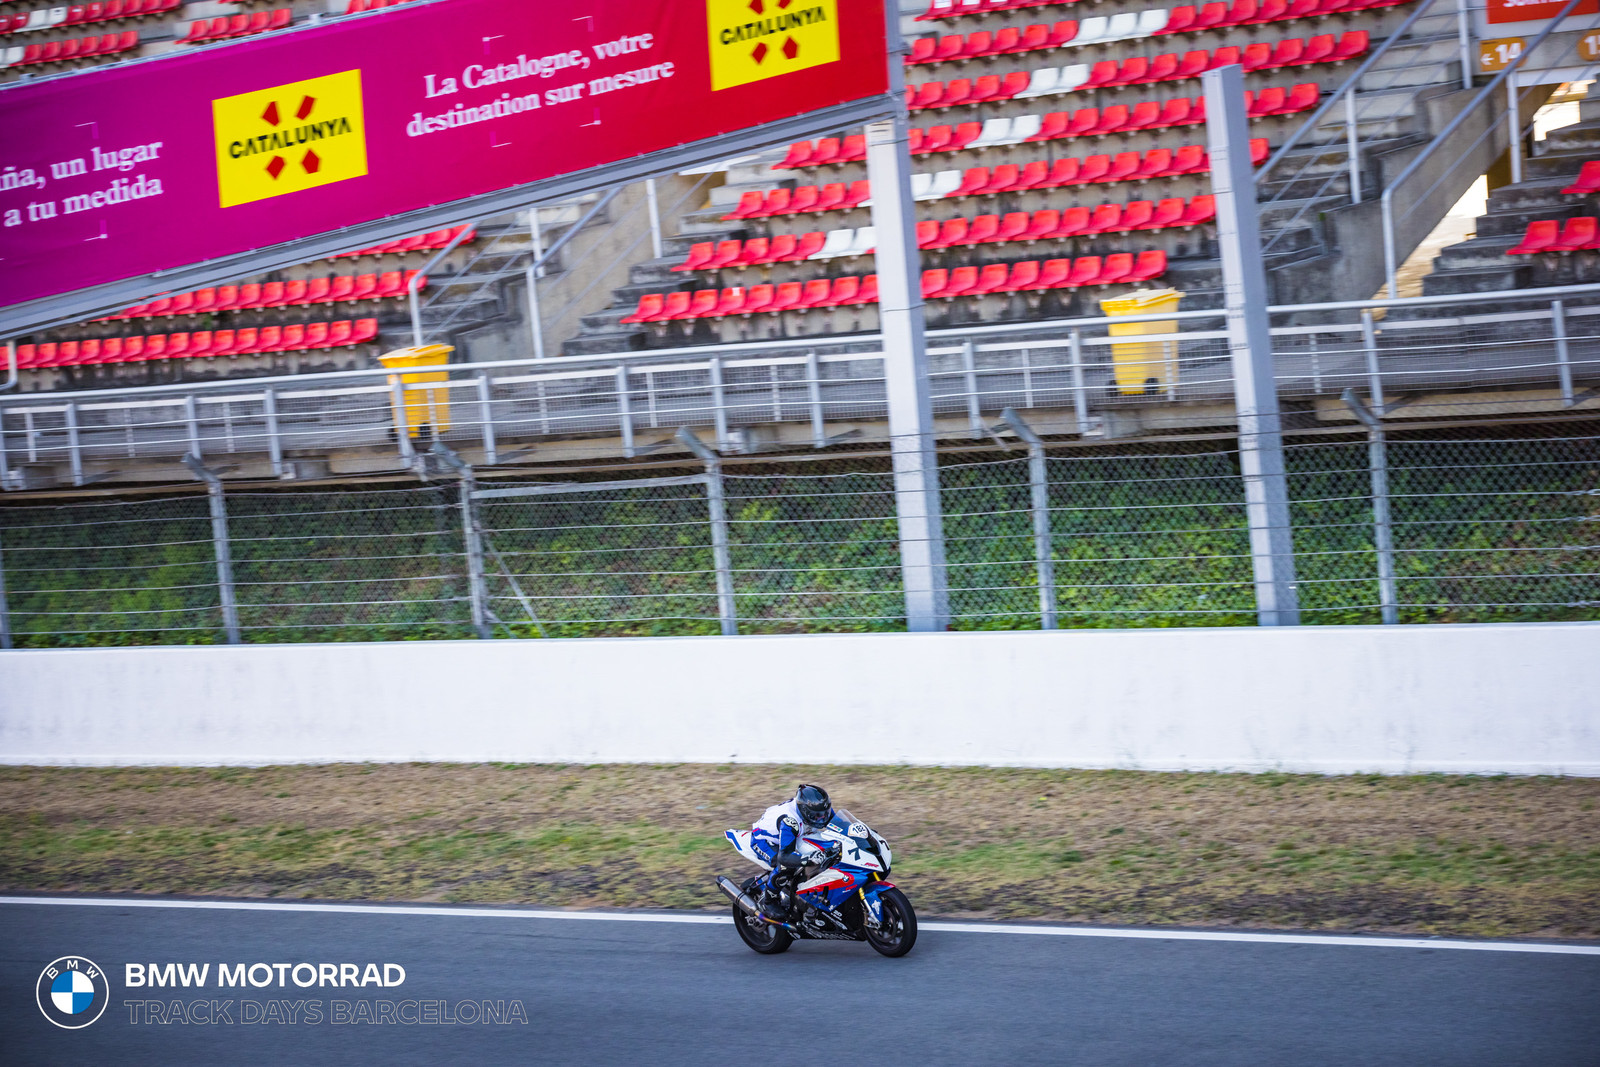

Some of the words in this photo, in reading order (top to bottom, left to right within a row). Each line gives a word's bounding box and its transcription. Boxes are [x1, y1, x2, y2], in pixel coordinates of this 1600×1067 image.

[720, 6, 827, 45] CATALUNYA
[424, 74, 459, 98] La
[462, 50, 591, 89] Catalogne,
[592, 32, 654, 60] votre
[406, 93, 542, 137] destination
[545, 82, 586, 106] sur
[588, 61, 675, 96] mesure
[228, 117, 352, 159] CATALUNYA
[50, 157, 88, 180] un
[90, 141, 163, 172] lugar
[3, 208, 23, 228] a
[27, 200, 58, 222] tu
[62, 174, 164, 215] medida
[847, 846, 861, 861] 7
